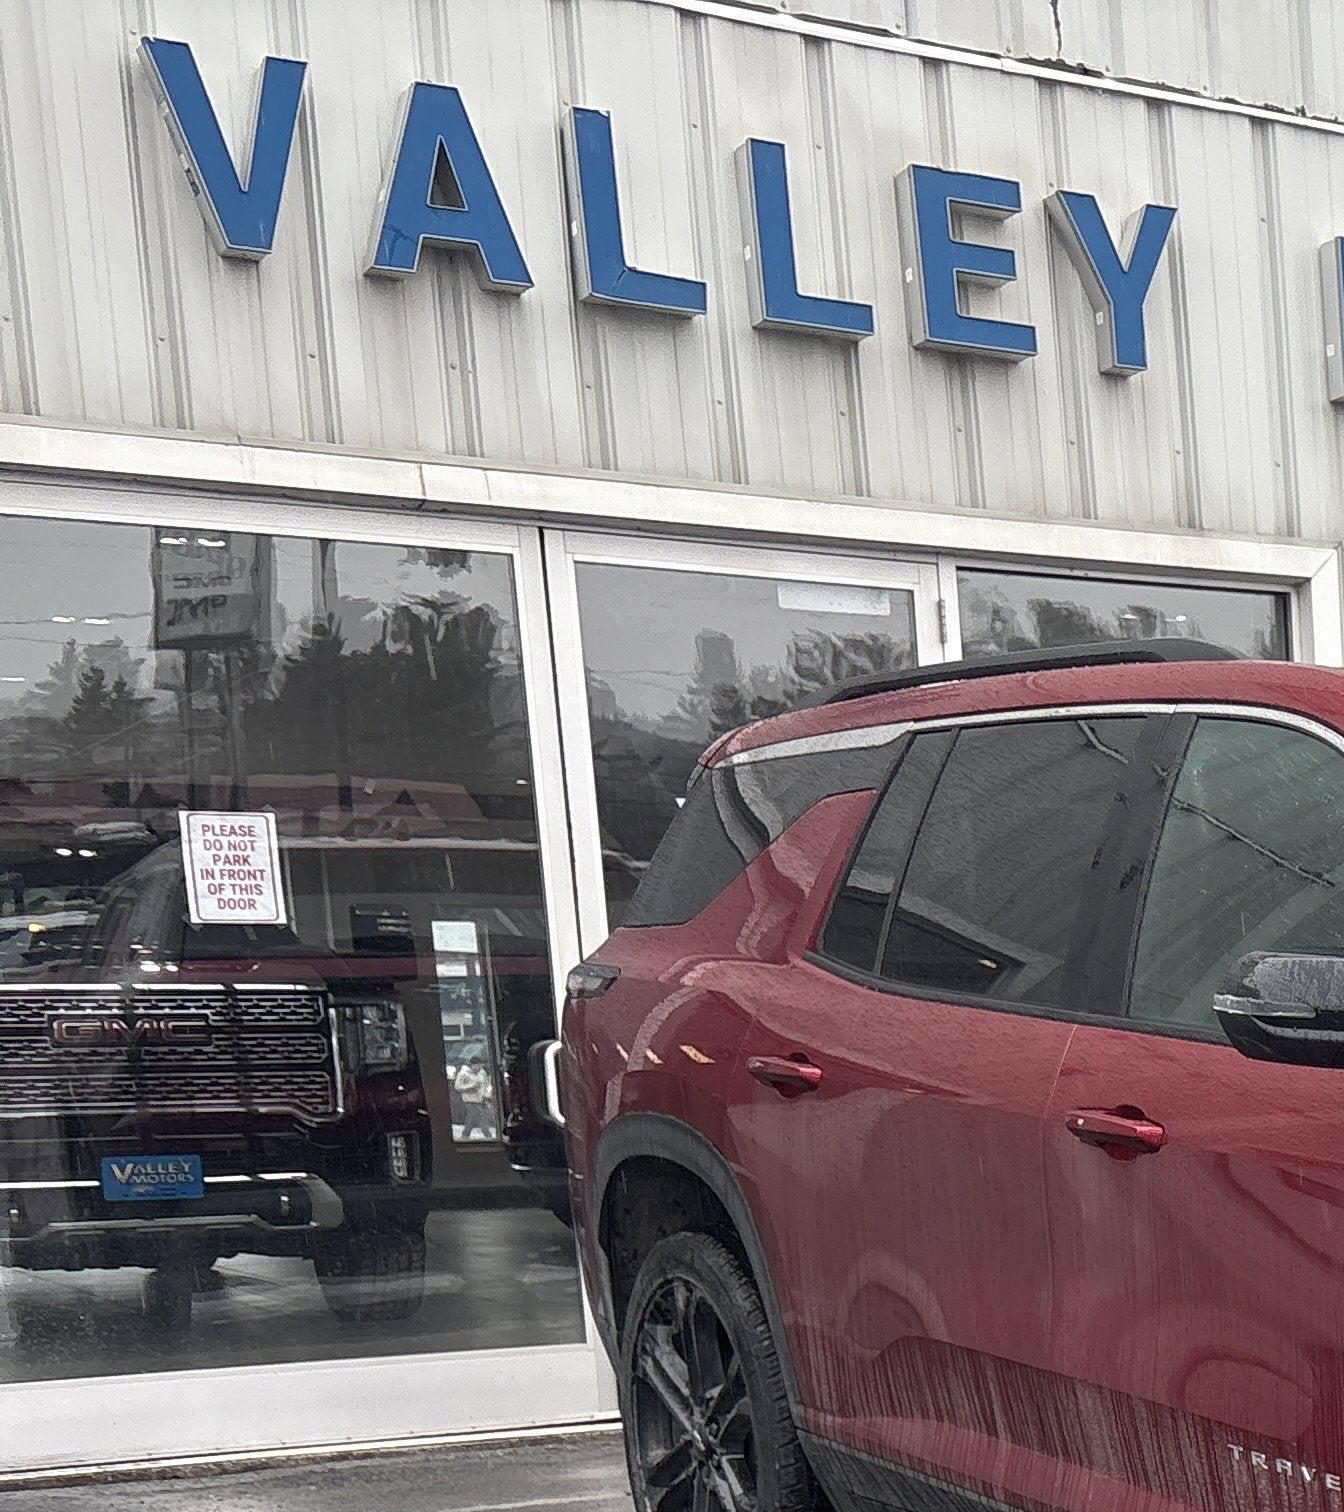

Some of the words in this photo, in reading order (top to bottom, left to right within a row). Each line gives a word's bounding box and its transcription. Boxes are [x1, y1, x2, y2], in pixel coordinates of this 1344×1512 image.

[140, 35, 1178, 377] VALLEY
[201, 823, 257, 838] PLEASE
[203, 838, 224, 852] DO
[227, 839, 257, 852] NOT
[212, 853, 252, 867] PARK
[200, 867, 216, 881] IN
[219, 868, 267, 882] FRONT
[207, 882, 226, 896] OF
[229, 883, 264, 896] THIS
[217, 897, 258, 911] DOOR
[52, 1017, 210, 1044] GMC
[111, 1160, 193, 1184] VALLEY
[130, 1173, 195, 1184] MOTORS
